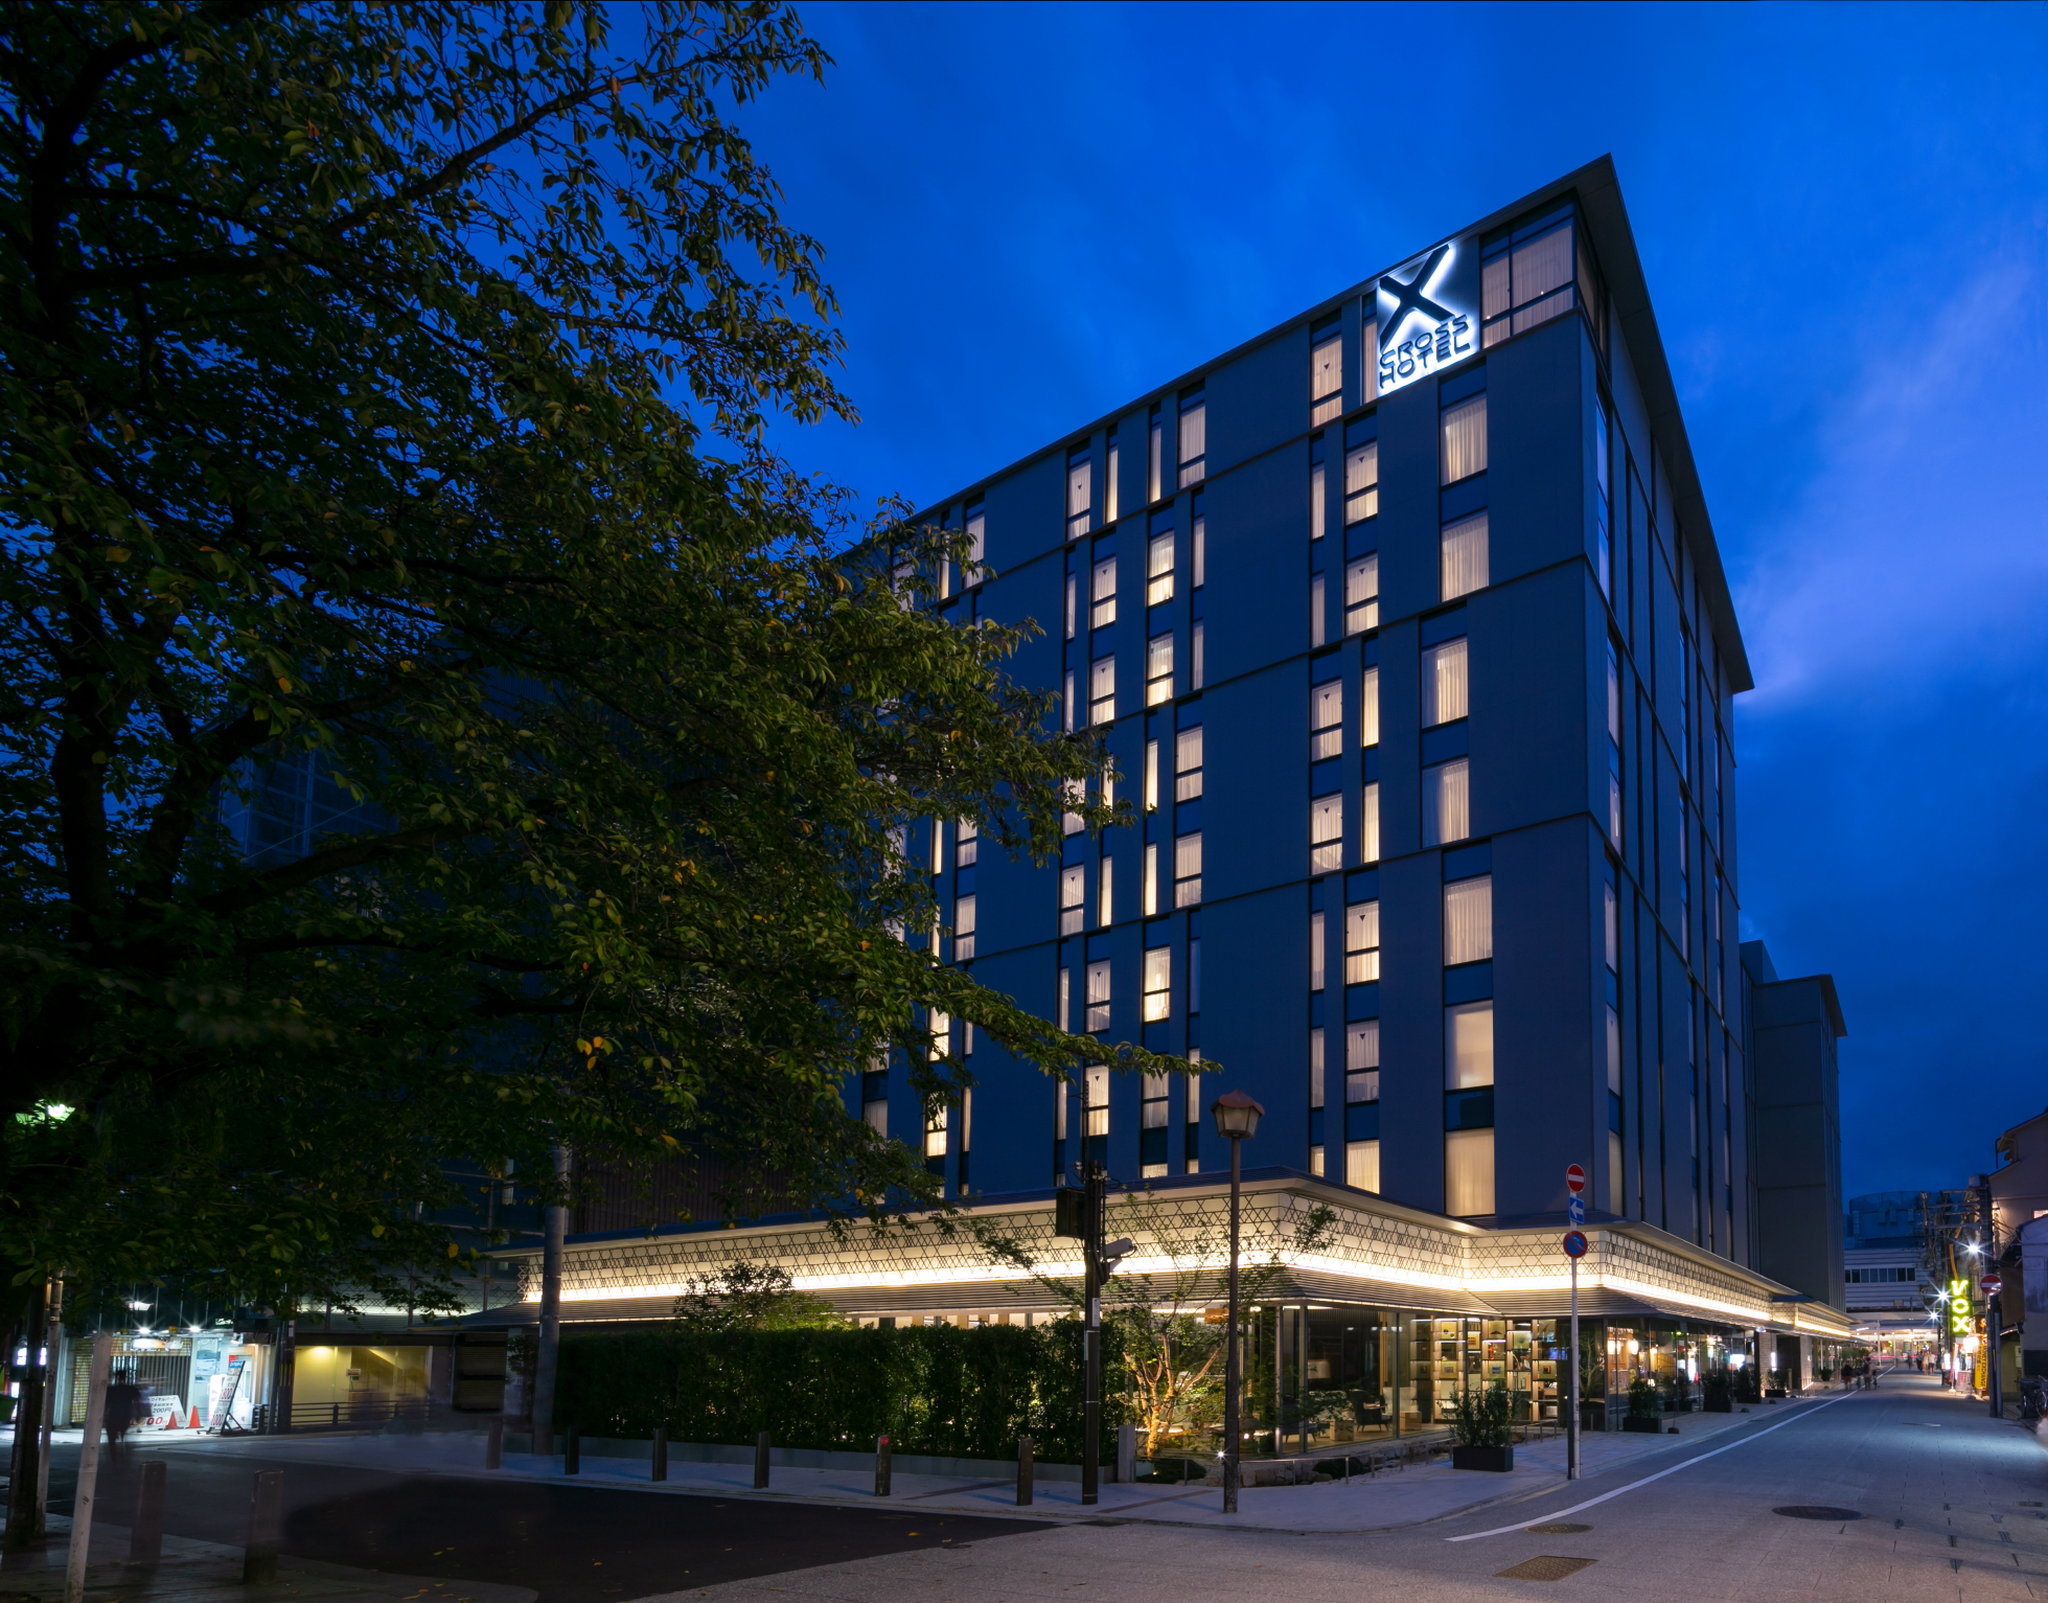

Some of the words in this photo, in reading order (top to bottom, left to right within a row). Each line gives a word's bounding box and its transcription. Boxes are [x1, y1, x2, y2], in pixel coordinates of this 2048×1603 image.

[1379, 314, 1469, 370] CROSS
[1379, 335, 1471, 389] HOTEL
[1951, 1280, 1971, 1332] VOX
